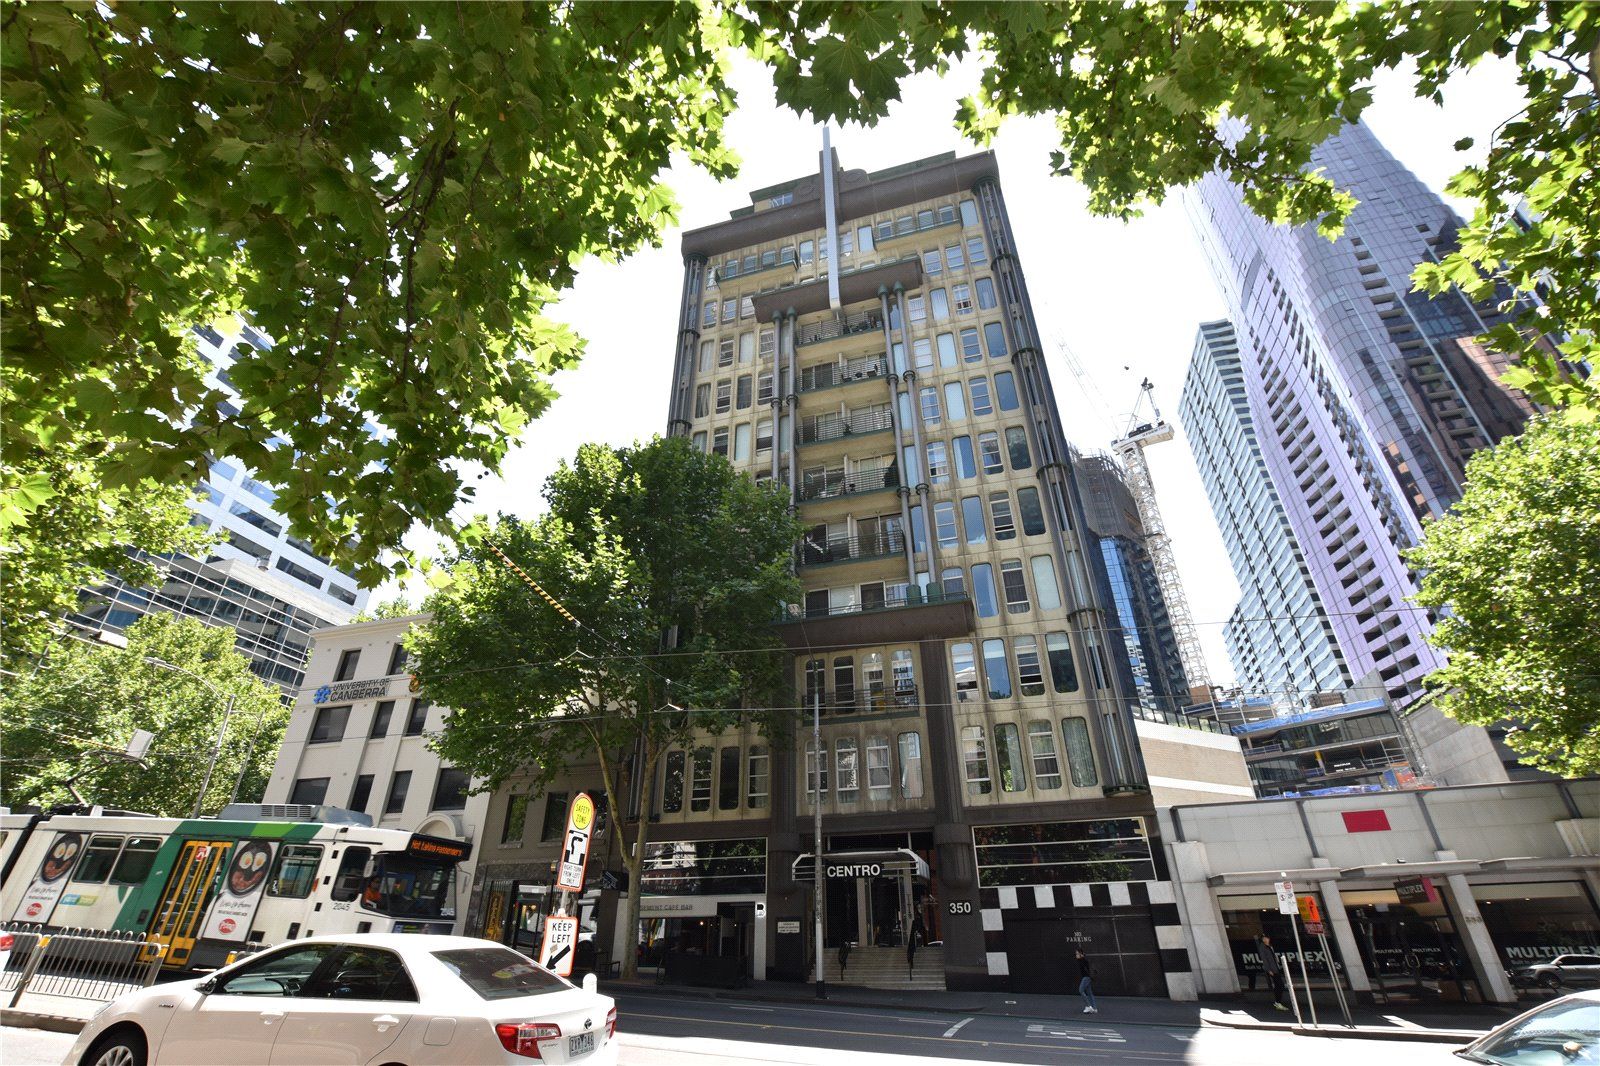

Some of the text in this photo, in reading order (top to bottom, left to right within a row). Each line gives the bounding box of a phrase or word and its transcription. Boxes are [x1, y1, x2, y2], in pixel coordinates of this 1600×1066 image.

[333, 678, 390, 691] UNIVERSITY OF
[331, 687, 386, 701] CANBERRA
[576, 804, 590, 815] SAFETY
[575, 814, 587, 825] ZONE
[827, 864, 881, 877] CENTRO
[333, 902, 350, 911] 2045
[950, 902, 971, 913] 350
[552, 922, 573, 932] KEEP
[552, 934, 571, 943] LEFT
[1505, 946, 1600, 959] MULTIPLEX
